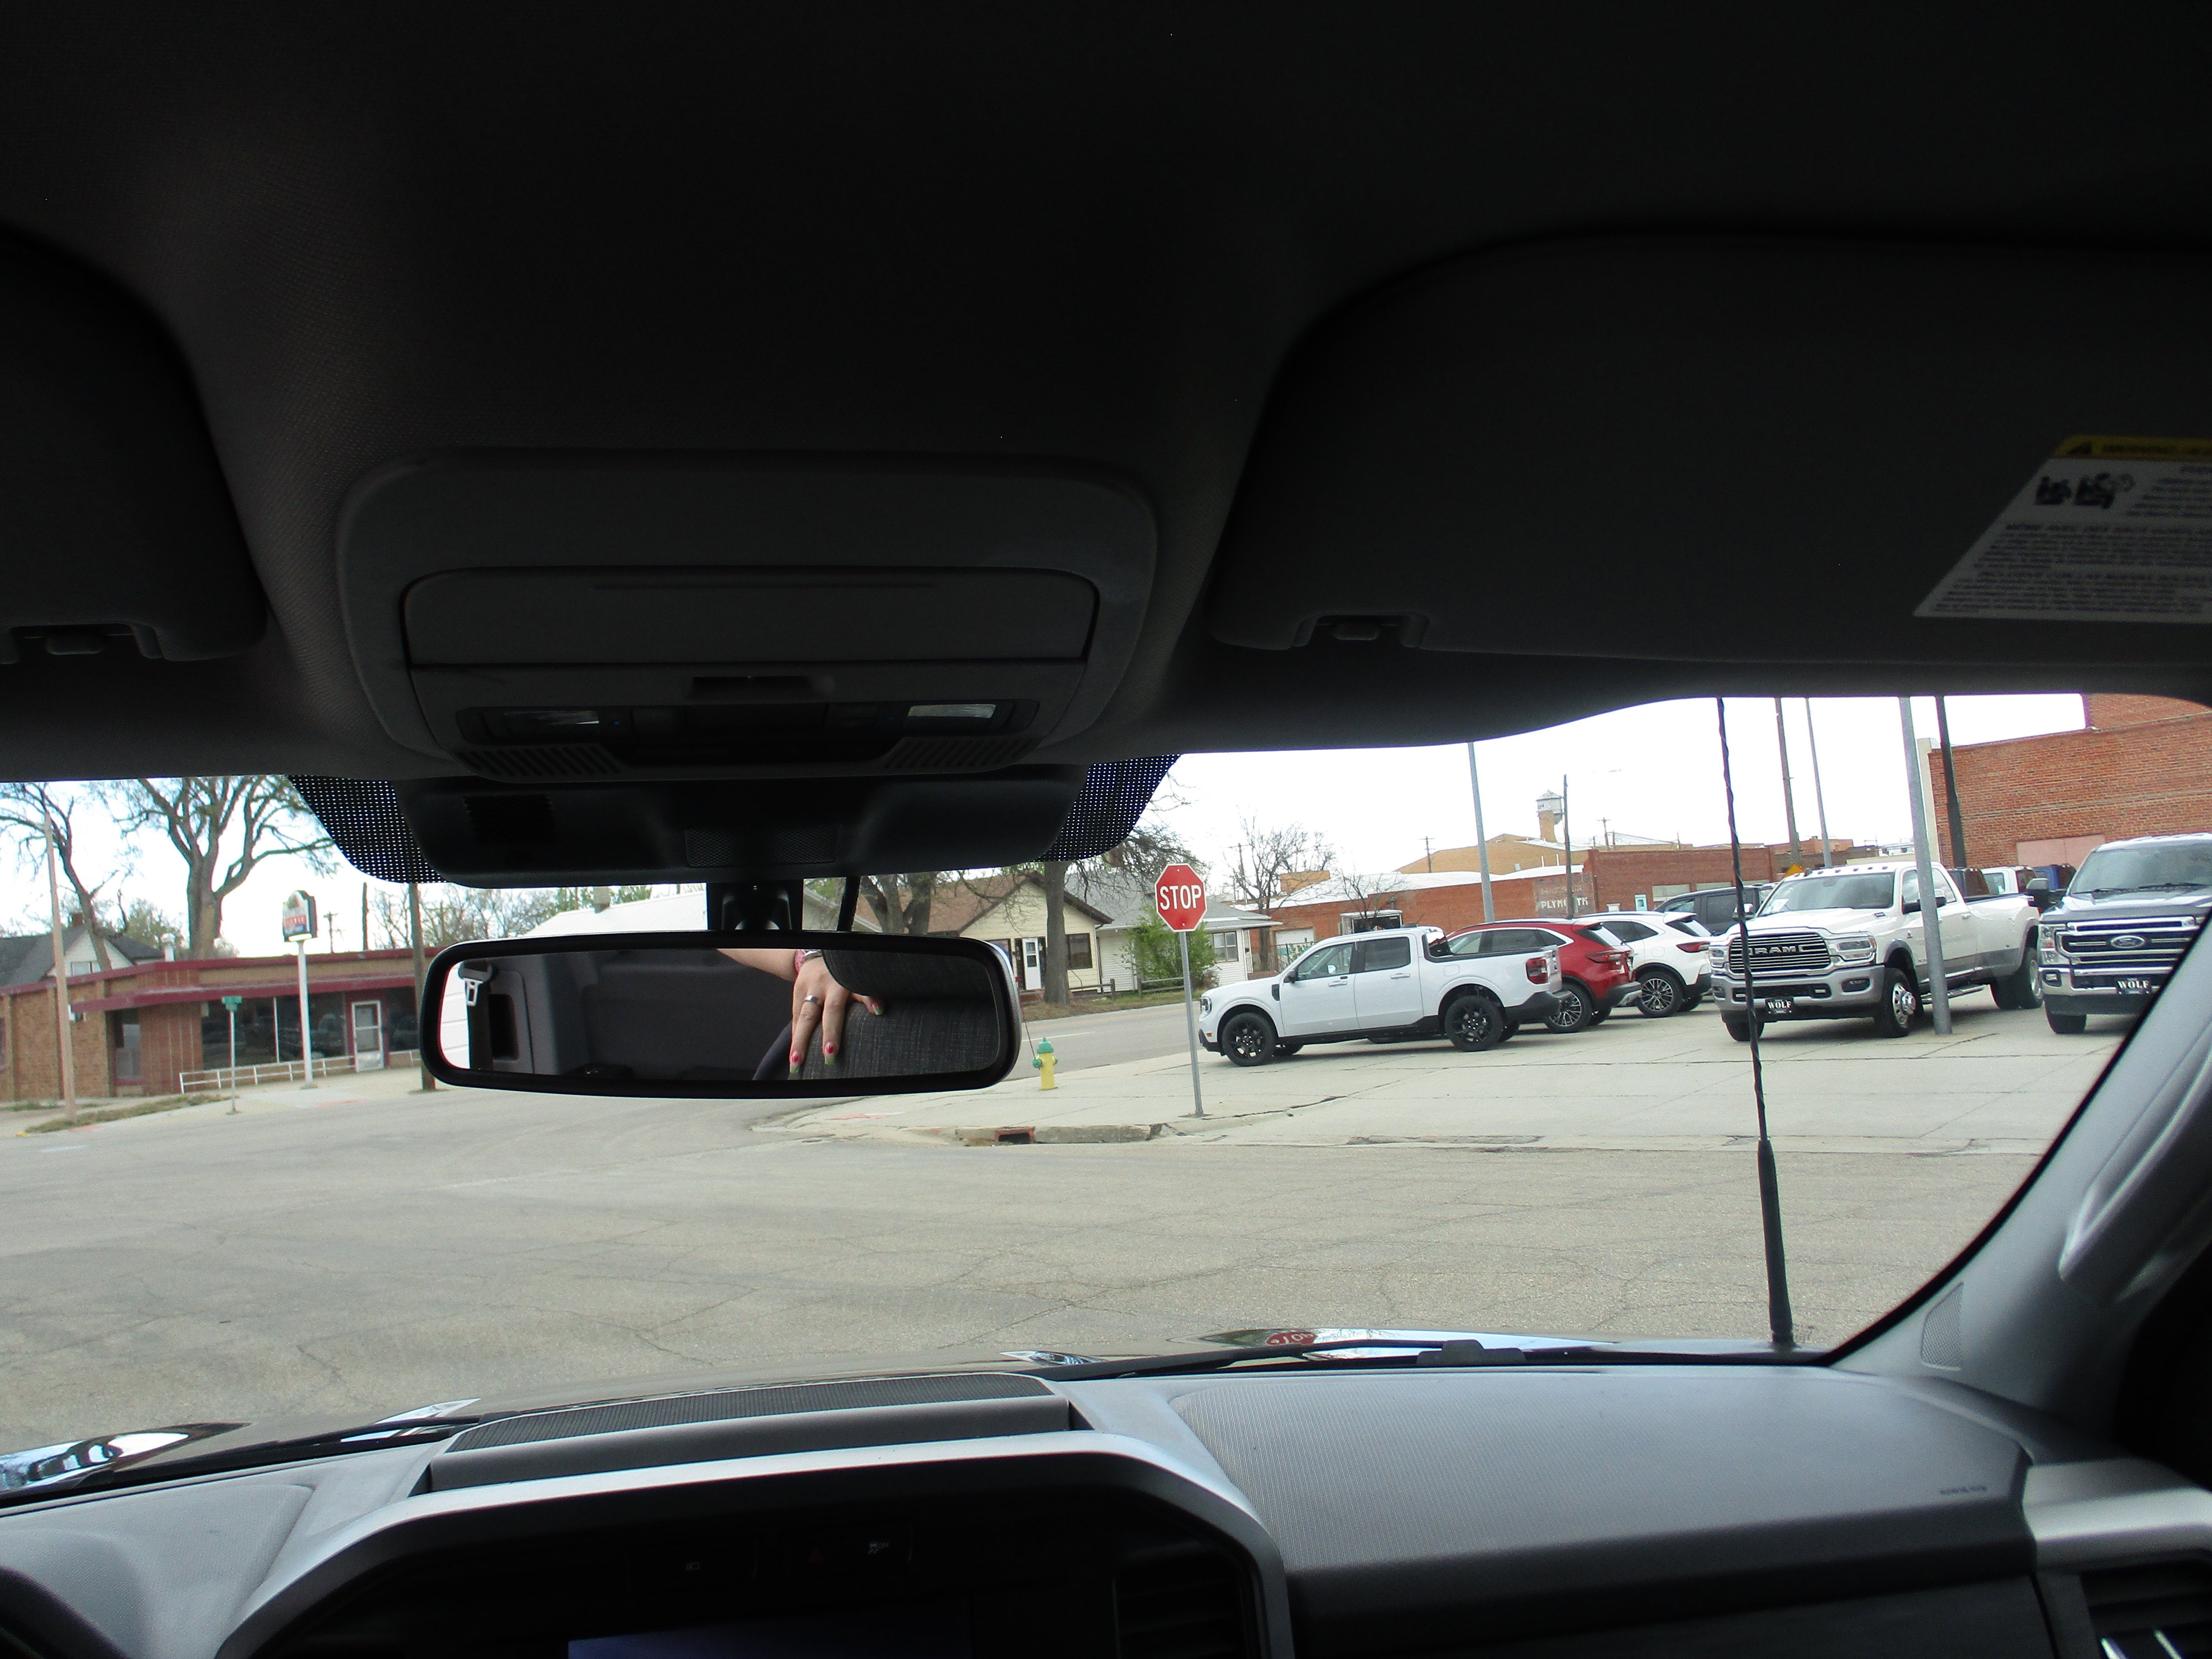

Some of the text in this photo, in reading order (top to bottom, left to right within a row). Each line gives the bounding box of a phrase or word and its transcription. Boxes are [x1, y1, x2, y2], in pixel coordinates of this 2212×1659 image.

[1160, 885, 1202, 910] STOP
[1754, 946, 1796, 954] RAM
[2117, 981, 2149, 989] WOLF
[1767, 1000, 1791, 1009] WOLF
